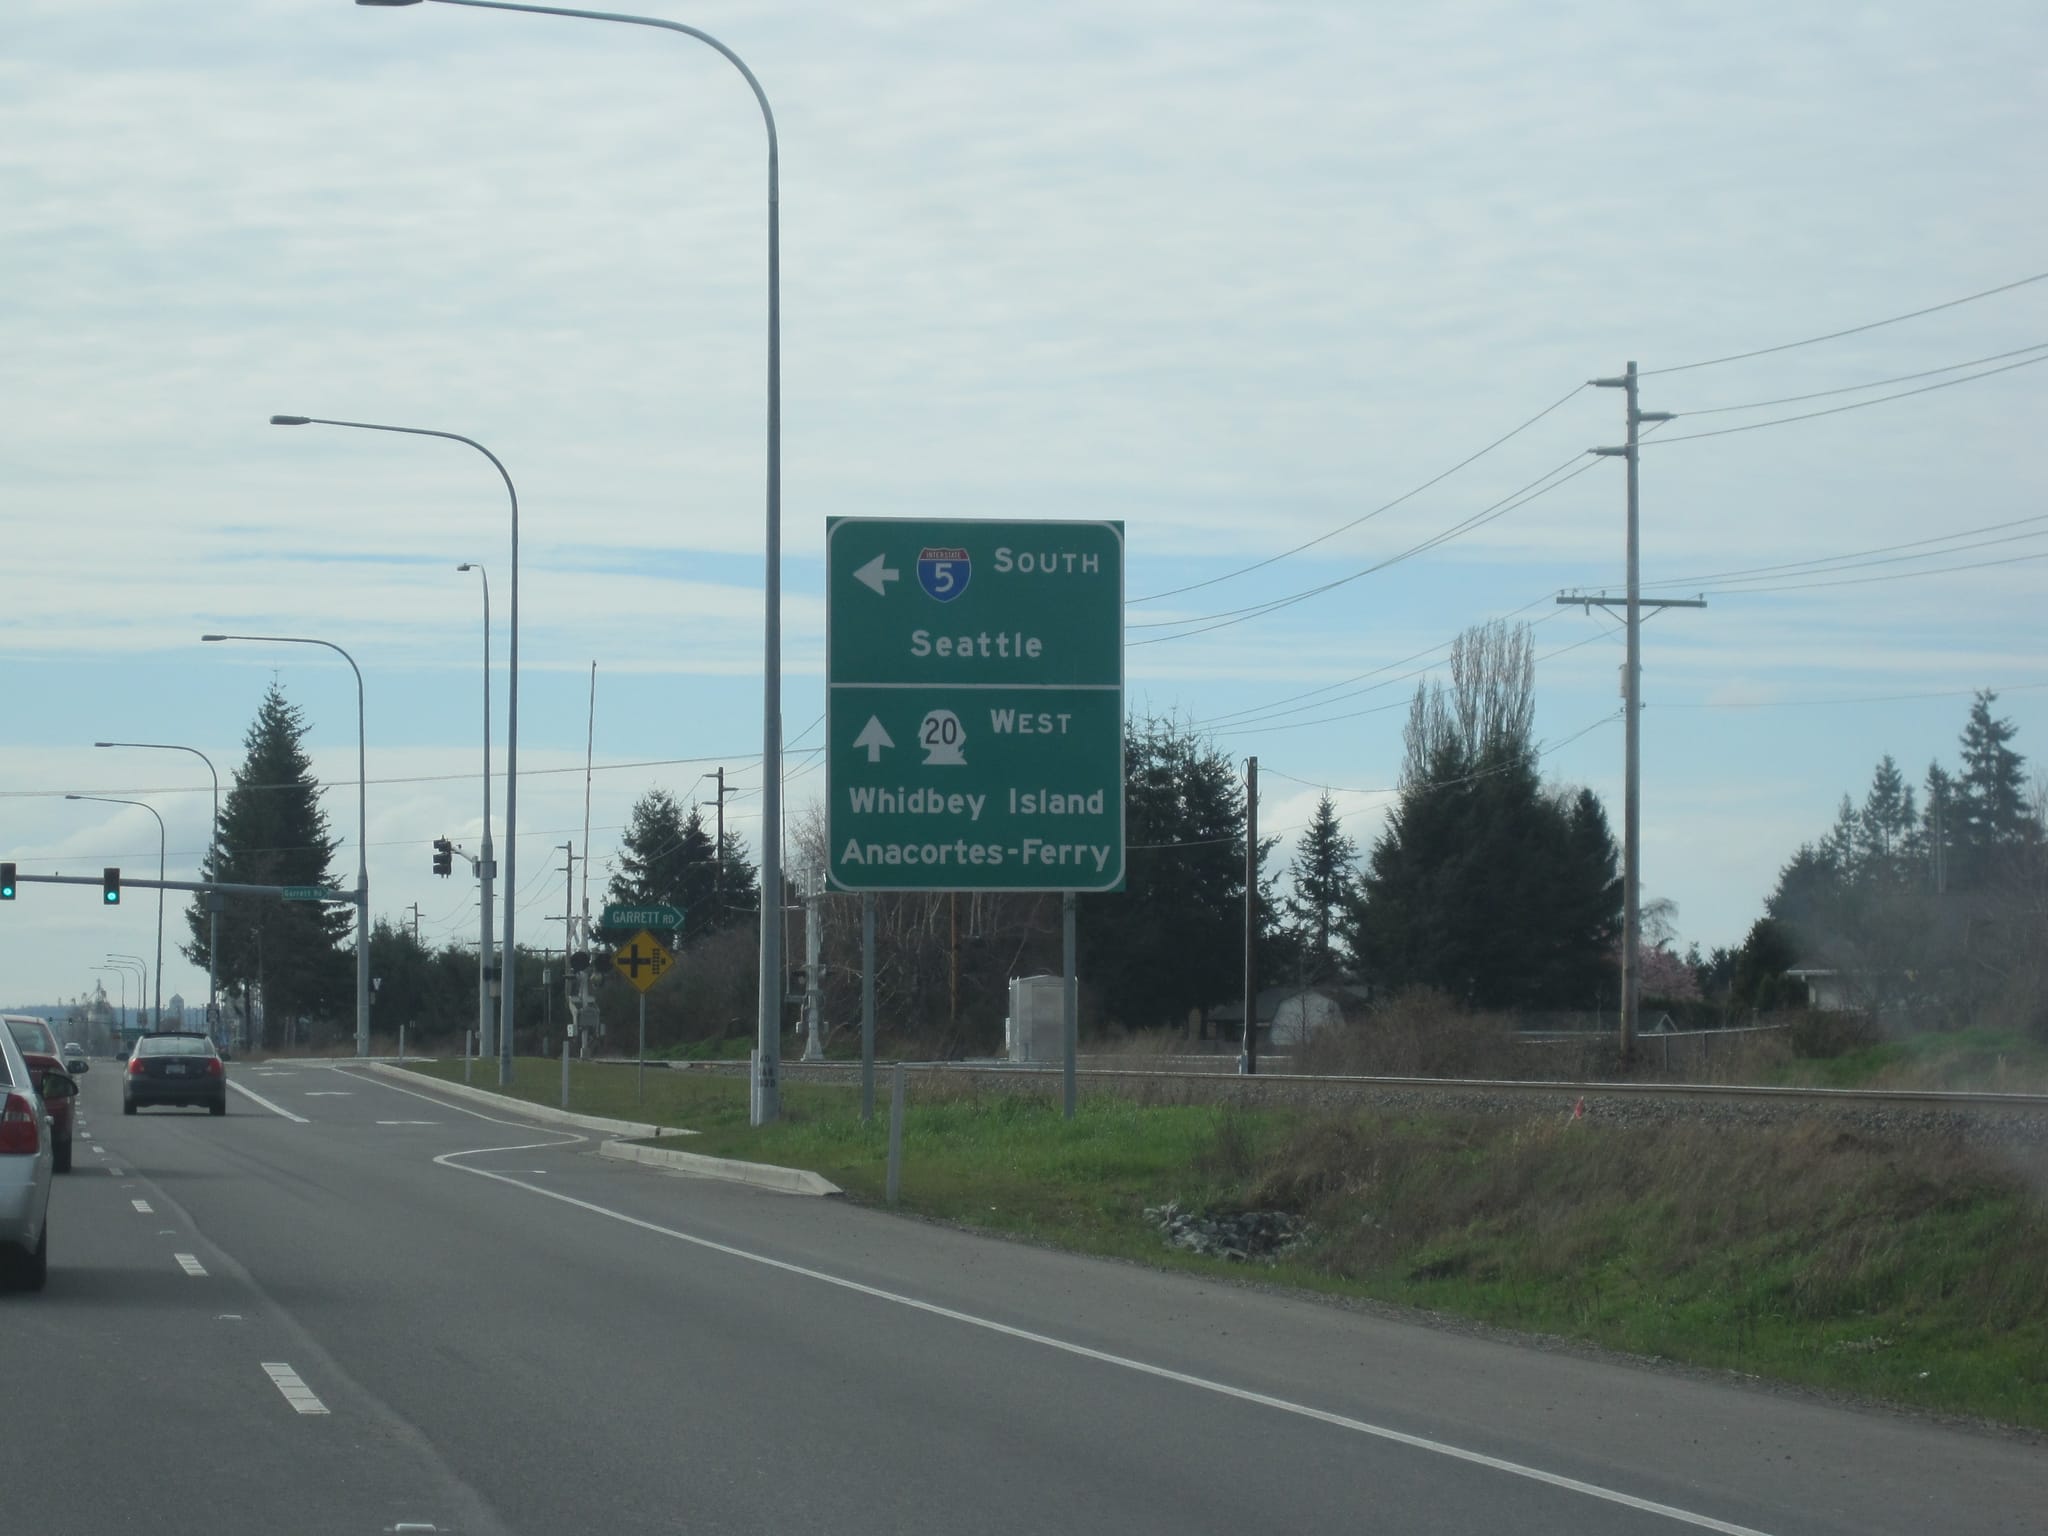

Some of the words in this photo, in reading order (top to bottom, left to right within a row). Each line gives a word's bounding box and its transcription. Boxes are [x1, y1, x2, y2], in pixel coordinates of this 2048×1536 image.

[935, 562, 954, 592] 5
[994, 547, 1099, 574] SOUTH
[911, 630, 1043, 657] Seattle
[925, 718, 957, 744] 20
[990, 709, 1072, 734] WEST
[849, 787, 986, 821] Whidbey
[1009, 788, 1104, 815] Island
[840, 838, 1111, 872] Anacortes-Ferry
[612, 911, 660, 924] GARRETT
[662, 914, 674, 924] RD
